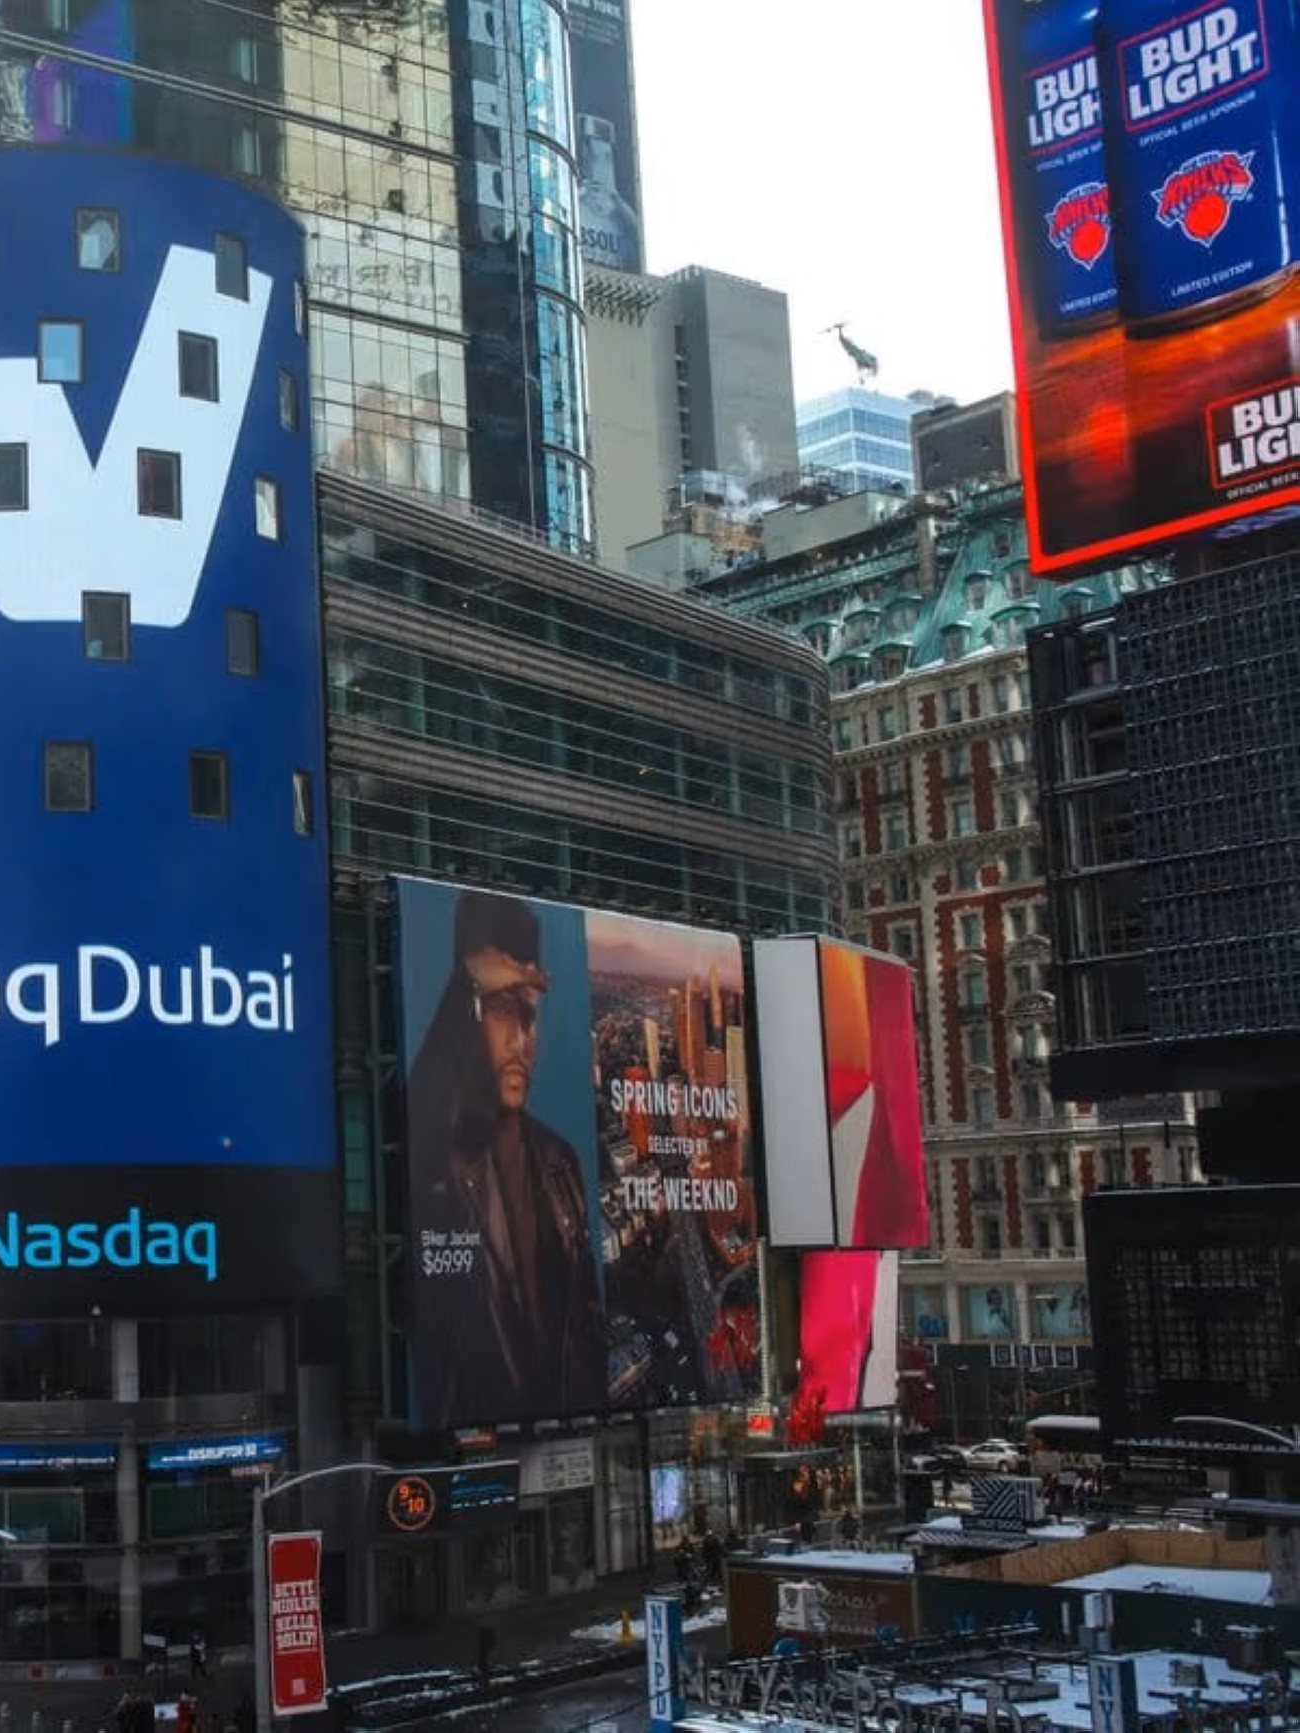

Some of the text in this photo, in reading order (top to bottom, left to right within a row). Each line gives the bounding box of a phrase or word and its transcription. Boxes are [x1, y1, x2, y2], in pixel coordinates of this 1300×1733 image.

[1140, 7, 1238, 78] BUD
[1128, 31, 1258, 120] LIGHT
[1171, 261, 1253, 298] LIMITED EDITION
[77, 945, 294, 1032] Dubai
[610, 1078, 738, 1119] SPRING ICONS
[648, 1134, 694, 1156] SELECTED
[619, 1176, 739, 1213] THE WEEKND
